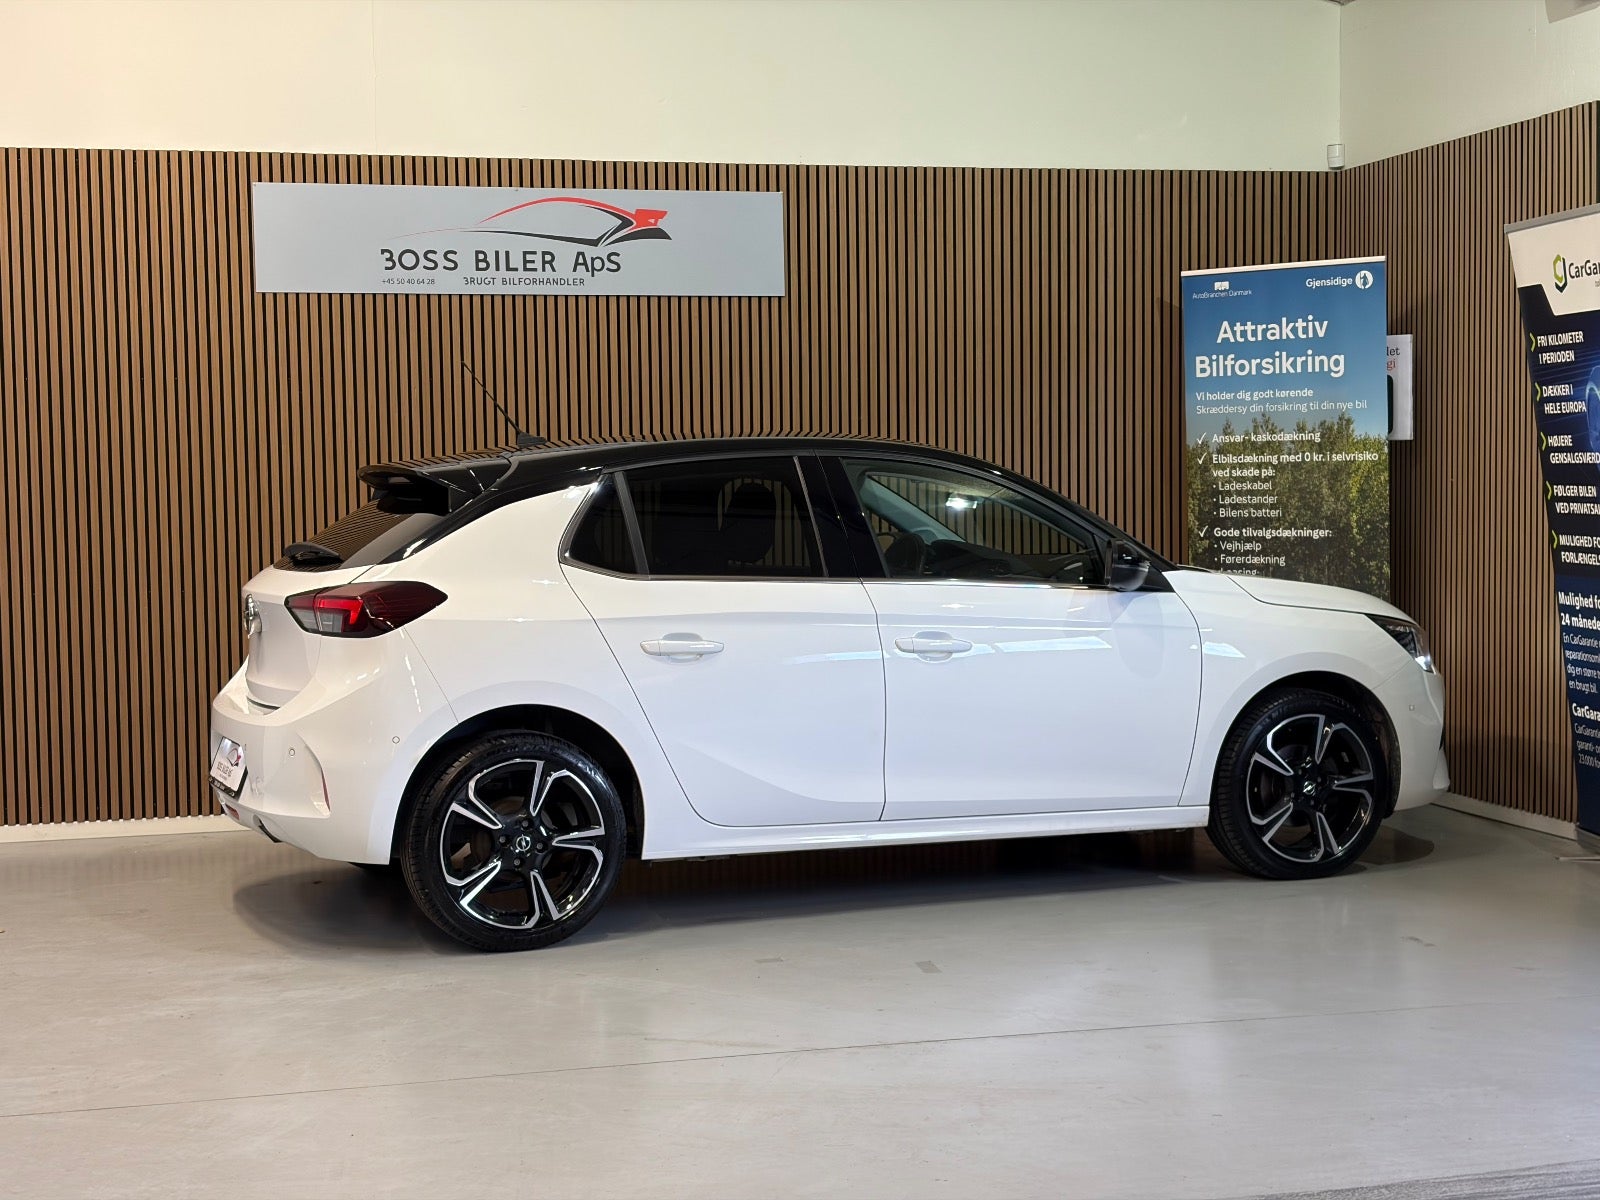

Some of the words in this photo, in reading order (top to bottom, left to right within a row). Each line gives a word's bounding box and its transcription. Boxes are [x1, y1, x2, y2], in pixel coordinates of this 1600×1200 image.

[474, 249, 557, 273] BILER
[572, 251, 622, 278] ApS
[501, 277, 585, 287] BILFORHANDLER
[1305, 276, 1353, 289] Gjensidige
[1228, 289, 1252, 297] Danmark
[1216, 315, 1328, 344] Attraktiv
[1537, 334, 1548, 347] FRI
[1548, 331, 1584, 346] KILOMETER
[1542, 350, 1575, 364] PERIODEN
[1195, 350, 1345, 378] Bilforsikring
[1196, 391, 1206, 401] Vi
[1206, 391, 1234, 401] holder
[1236, 390, 1251, 402] dig
[1253, 389, 1274, 401] godt
[1275, 388, 1314, 399] kørende
[1542, 384, 1569, 397] DÆKKER
[1196, 404, 1247, 415] Skræddersy
[1250, 403, 1264, 413] din
[1265, 402, 1308, 413] forsikring
[1309, 401, 1319, 410] til
[1321, 401, 1335, 410] din
[1337, 402, 1353, 411] nye
[1355, 400, 1367, 409] bil
[1544, 402, 1561, 414] HELE
[1561, 400, 1587, 413] EUROPA
[1212, 433, 1249, 443] Ansvar-
[1251, 431, 1321, 443] kaskodækning
[1548, 434, 1573, 447] HØJERE
[1212, 453, 1278, 465] Elbilsdækning
[1280, 452, 1302, 463] med
[1304, 452, 1311, 462] 0
[1313, 452, 1325, 462] kr.
[1332, 452, 1379, 462] selvrisiko
[1213, 468, 1229, 477] ved
[1231, 468, 1260, 477] skade
[1261, 467, 1276, 479] på:
[1218, 481, 1273, 491] Ladeskabel
[1553, 484, 1578, 497] FØLGER
[1578, 485, 1597, 498] BILEN
[1219, 495, 1278, 504] Ladestander
[1219, 508, 1249, 518] Bilens
[1250, 507, 1282, 517] batteri
[1555, 502, 1569, 514] VED
[1213, 527, 1240, 537] Gode
[1242, 527, 1333, 539] tilvalgsdækninger:
[1220, 541, 1262, 552] Vejhjælp
[1559, 534, 1592, 548] MULIGHED
[1220, 554, 1286, 566] Førerdækning
[1558, 591, 1594, 610] Mulighed
[1560, 612, 1570, 626] 24
